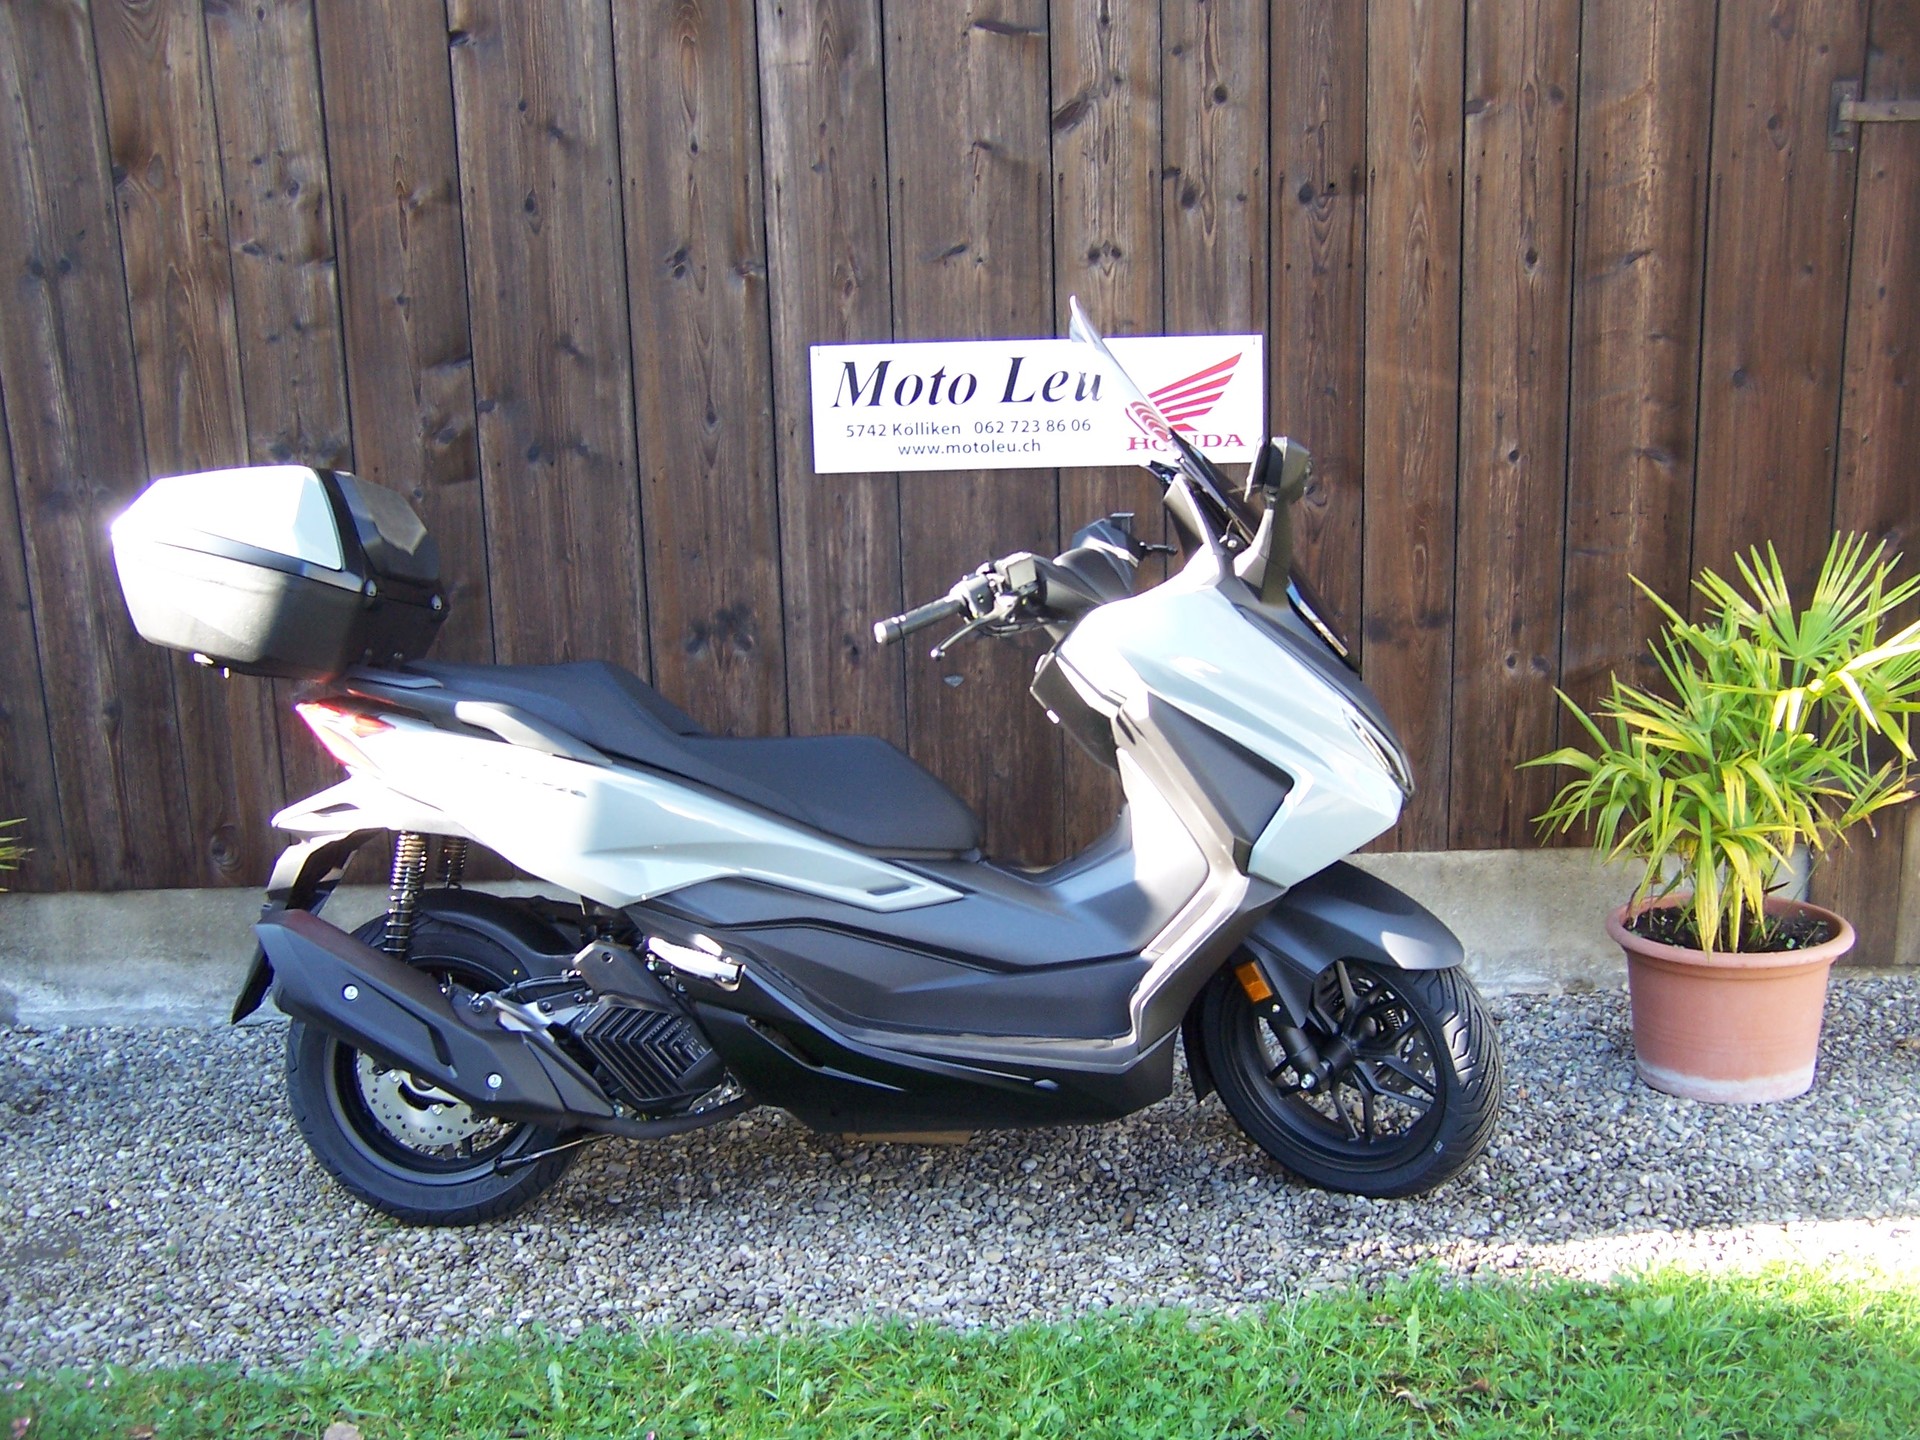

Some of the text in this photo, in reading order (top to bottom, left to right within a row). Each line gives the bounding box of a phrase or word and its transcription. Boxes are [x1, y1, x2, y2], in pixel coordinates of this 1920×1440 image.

[830, 356, 1103, 408] Moto Leu
[846, 418, 1092, 438] 5742 Kölliken 062 723 86 06
[897, 438, 1041, 455] www.motoleu.ch
